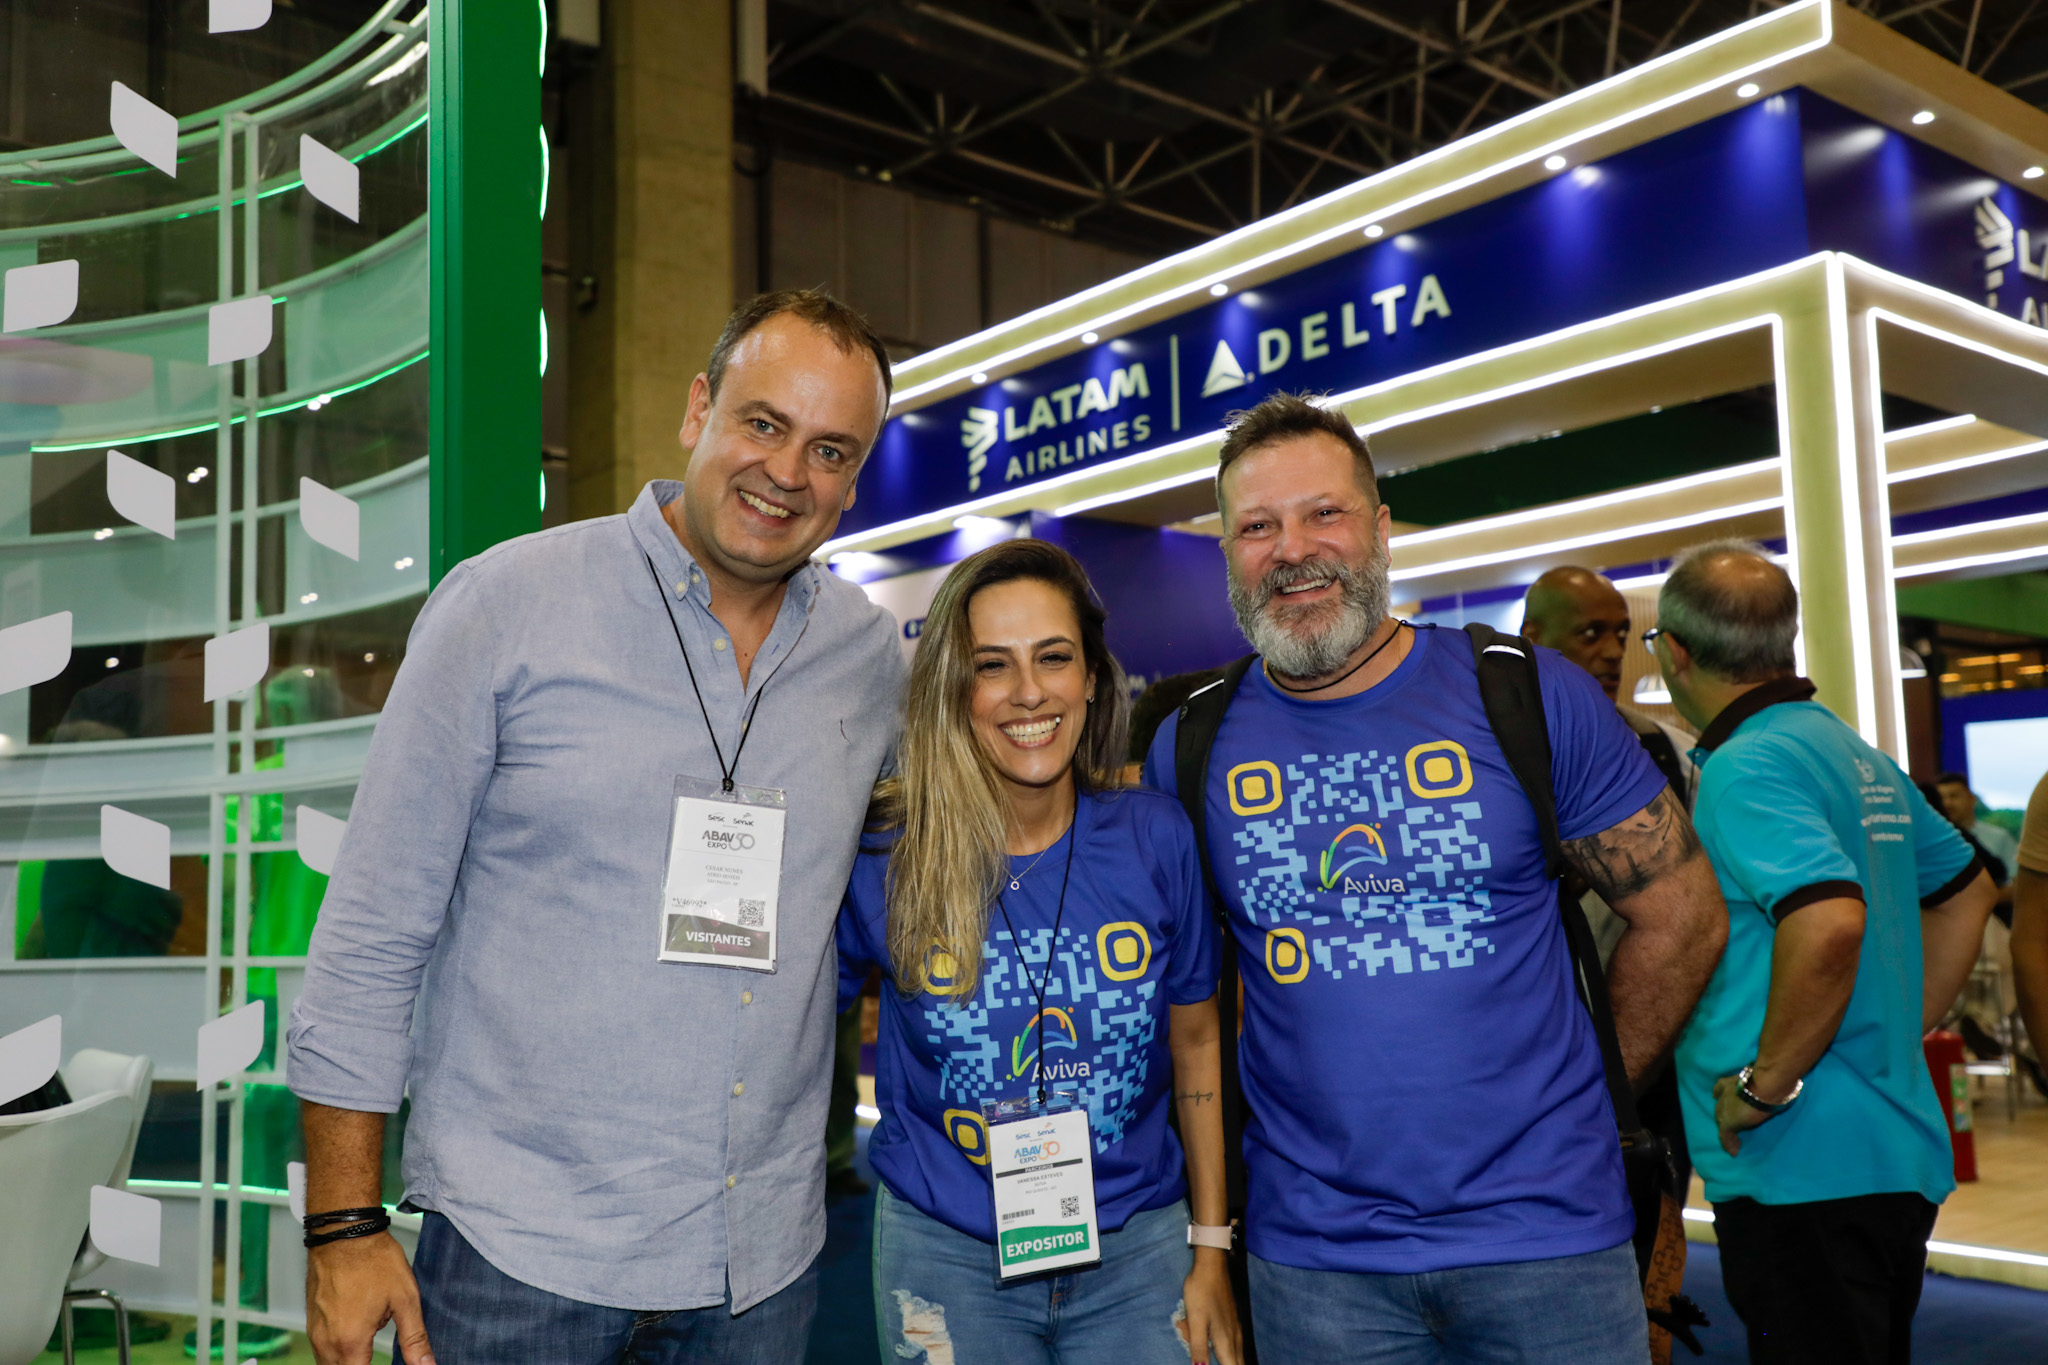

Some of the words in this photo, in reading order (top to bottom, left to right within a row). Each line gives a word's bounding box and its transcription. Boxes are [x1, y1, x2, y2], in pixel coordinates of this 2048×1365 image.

[1258, 274, 1452, 375] DELTA
[1004, 362, 1151, 443] LATAM
[1005, 414, 1151, 482] AIRLINES
[702, 830, 736, 843] ABAV
[728, 832, 755, 851] 50
[707, 841, 728, 850] EXPO
[1344, 873, 1405, 895] Aviva
[686, 931, 752, 947] VISITANTES
[1031, 1058, 1091, 1083] Aviva
[1014, 1144, 1042, 1160] ABAV
[1038, 1141, 1061, 1160] 50
[1019, 1155, 1037, 1164] EXPO
[1017, 1175, 1040, 1185] VANESSA
[1006, 1231, 1084, 1258] EXPOSITOR
